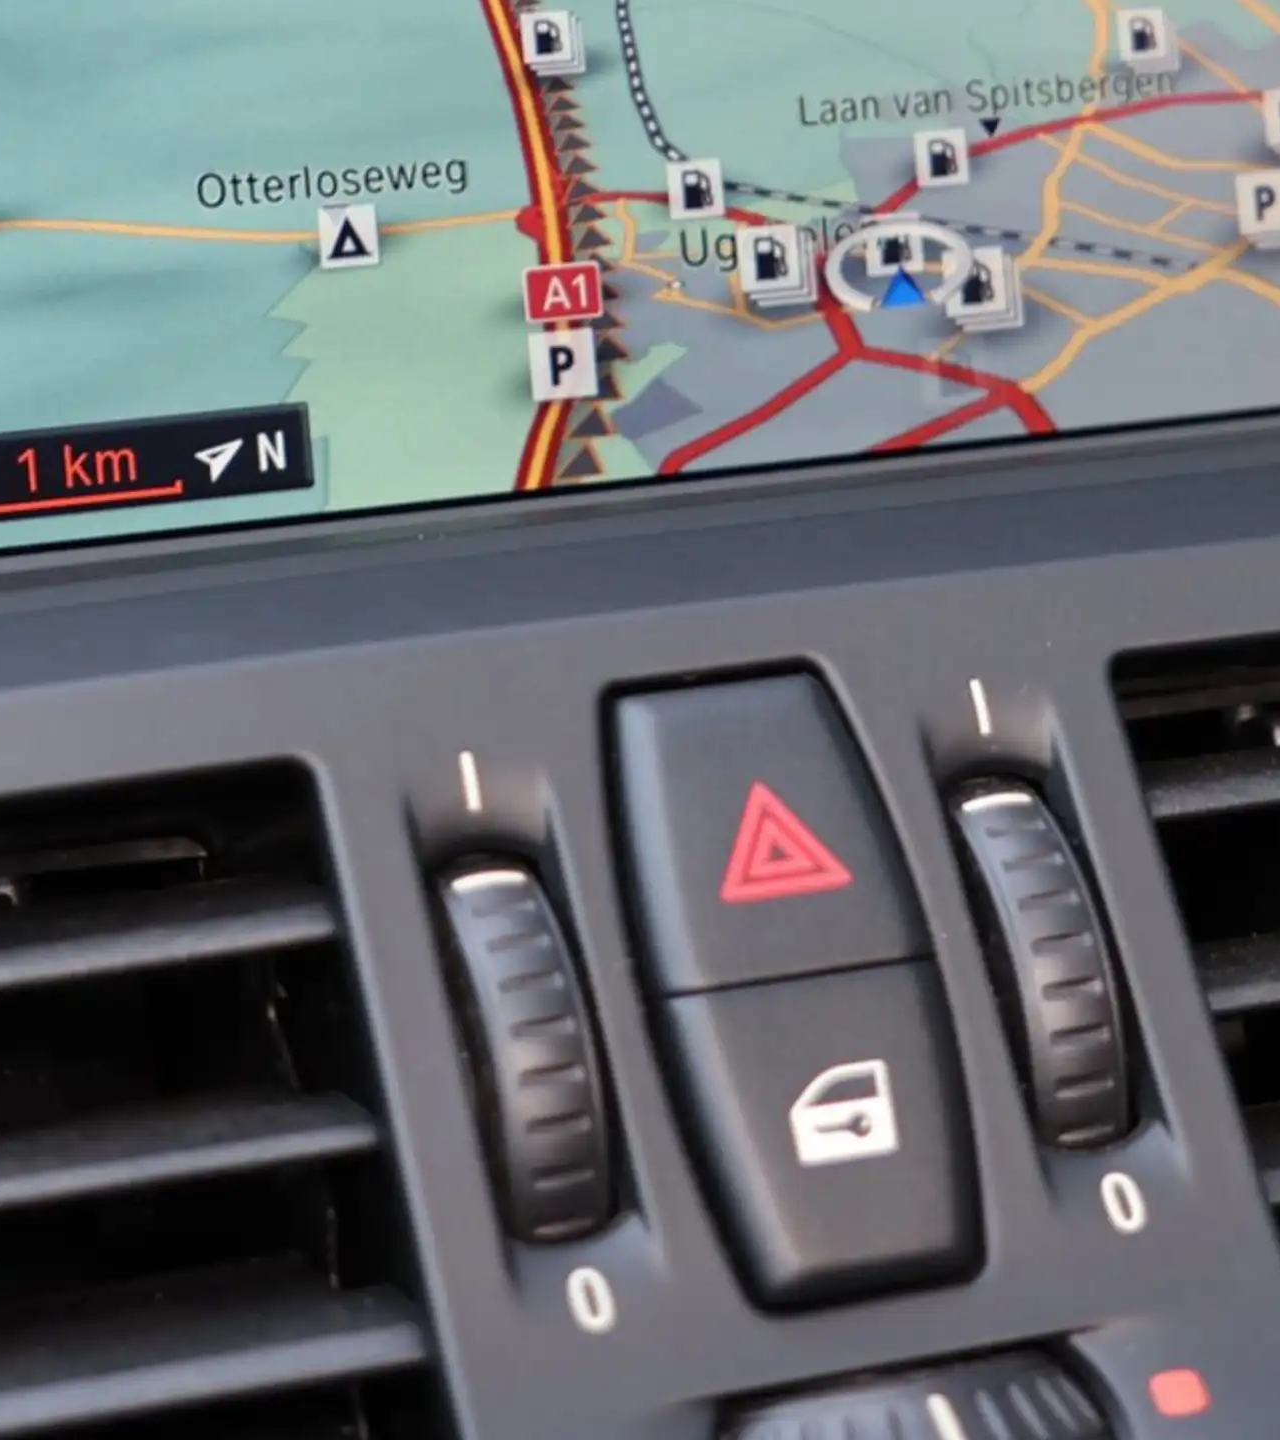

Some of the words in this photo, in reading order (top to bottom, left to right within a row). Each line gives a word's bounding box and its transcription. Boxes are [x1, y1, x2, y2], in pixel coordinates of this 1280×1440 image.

[798, 93, 880, 127] Laan
[892, 91, 953, 117] van
[964, 68, 1176, 114] Spitsbergen
[196, 157, 469, 209] Otterloseweg
[543, 272, 590, 311] A1
[18, 449, 38, 492] 1
[65, 446, 137, 487] km
[257, 430, 287, 472] N
